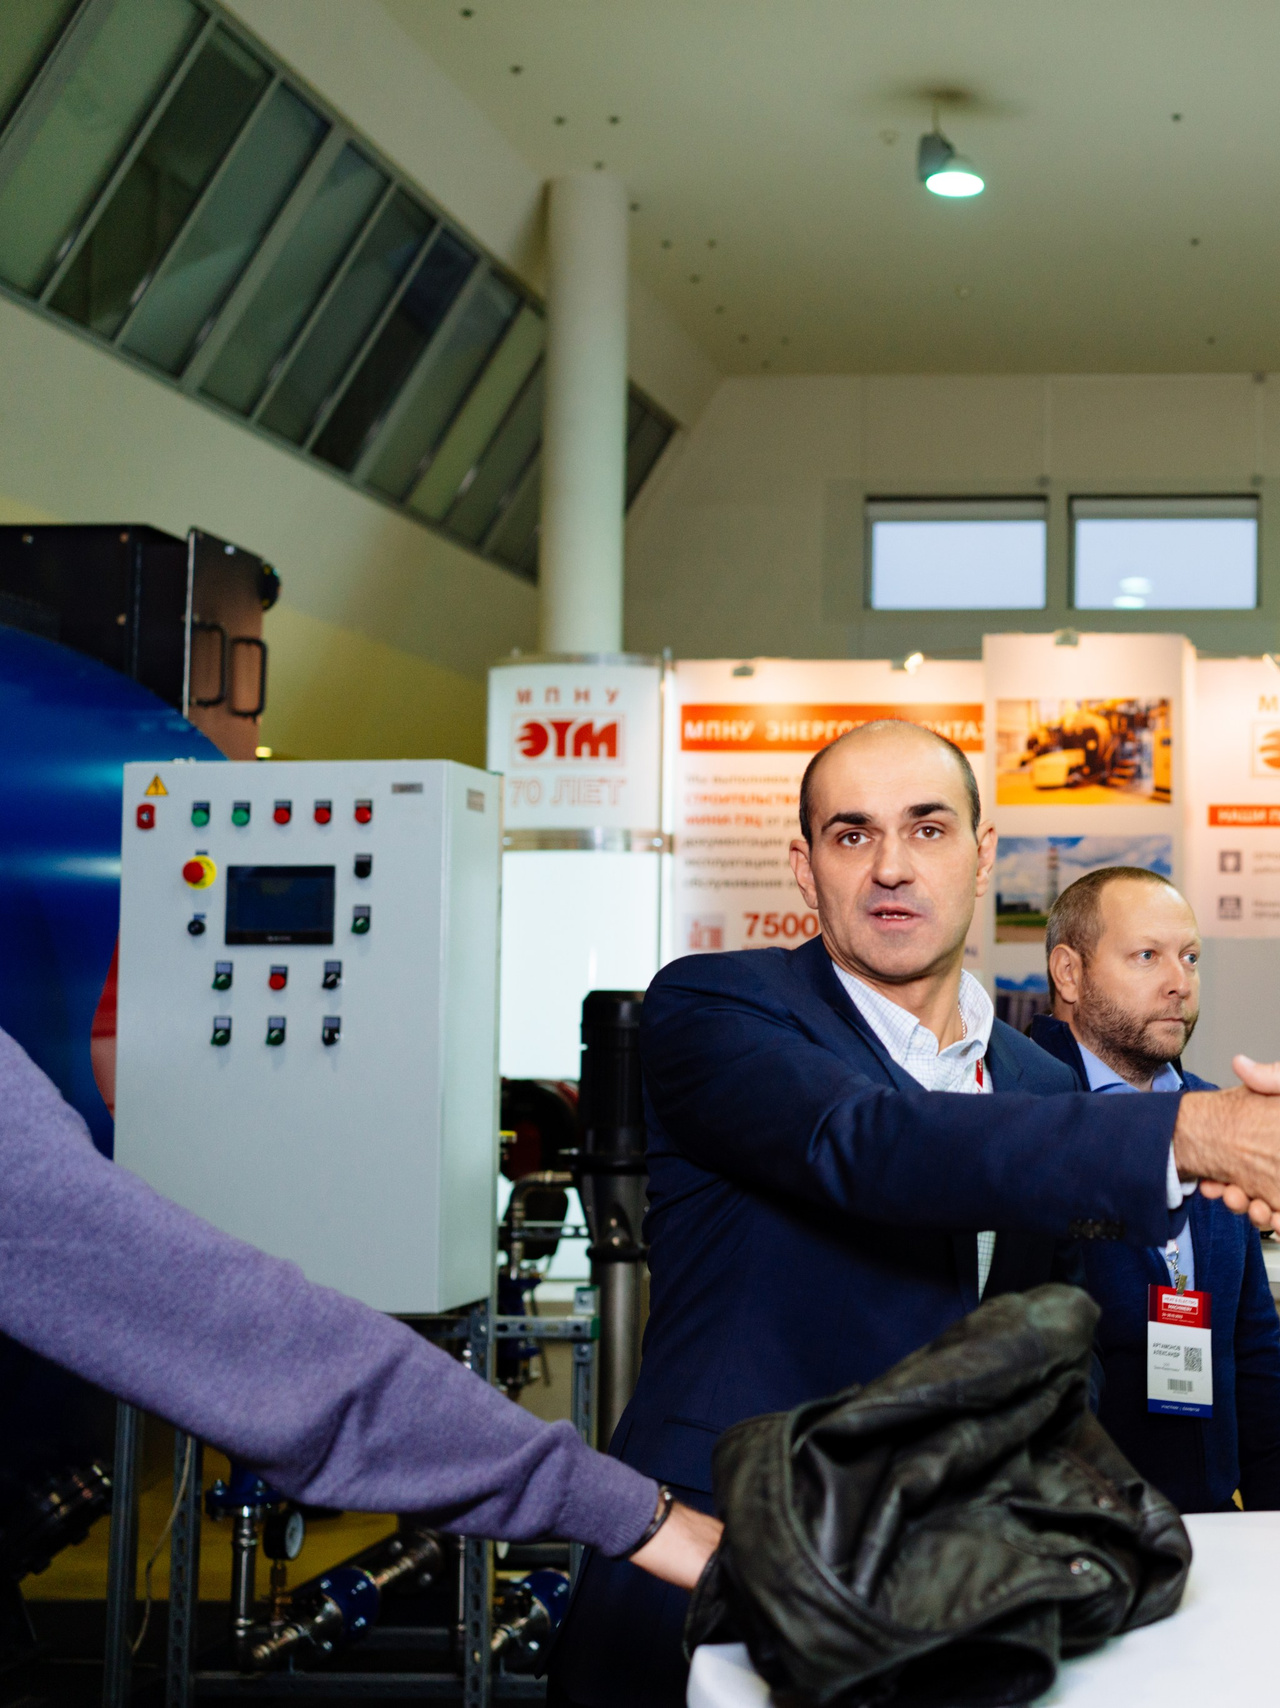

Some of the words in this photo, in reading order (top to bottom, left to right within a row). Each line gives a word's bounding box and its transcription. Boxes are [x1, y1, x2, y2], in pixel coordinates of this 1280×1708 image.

[516, 719, 617, 758] ЭТМ
[684, 720, 756, 741] МПНУ
[511, 779, 541, 805] 70
[552, 779, 627, 806] ЛЕТ
[1218, 809, 1266, 823] НАШИ
[744, 912, 819, 938] 7500
